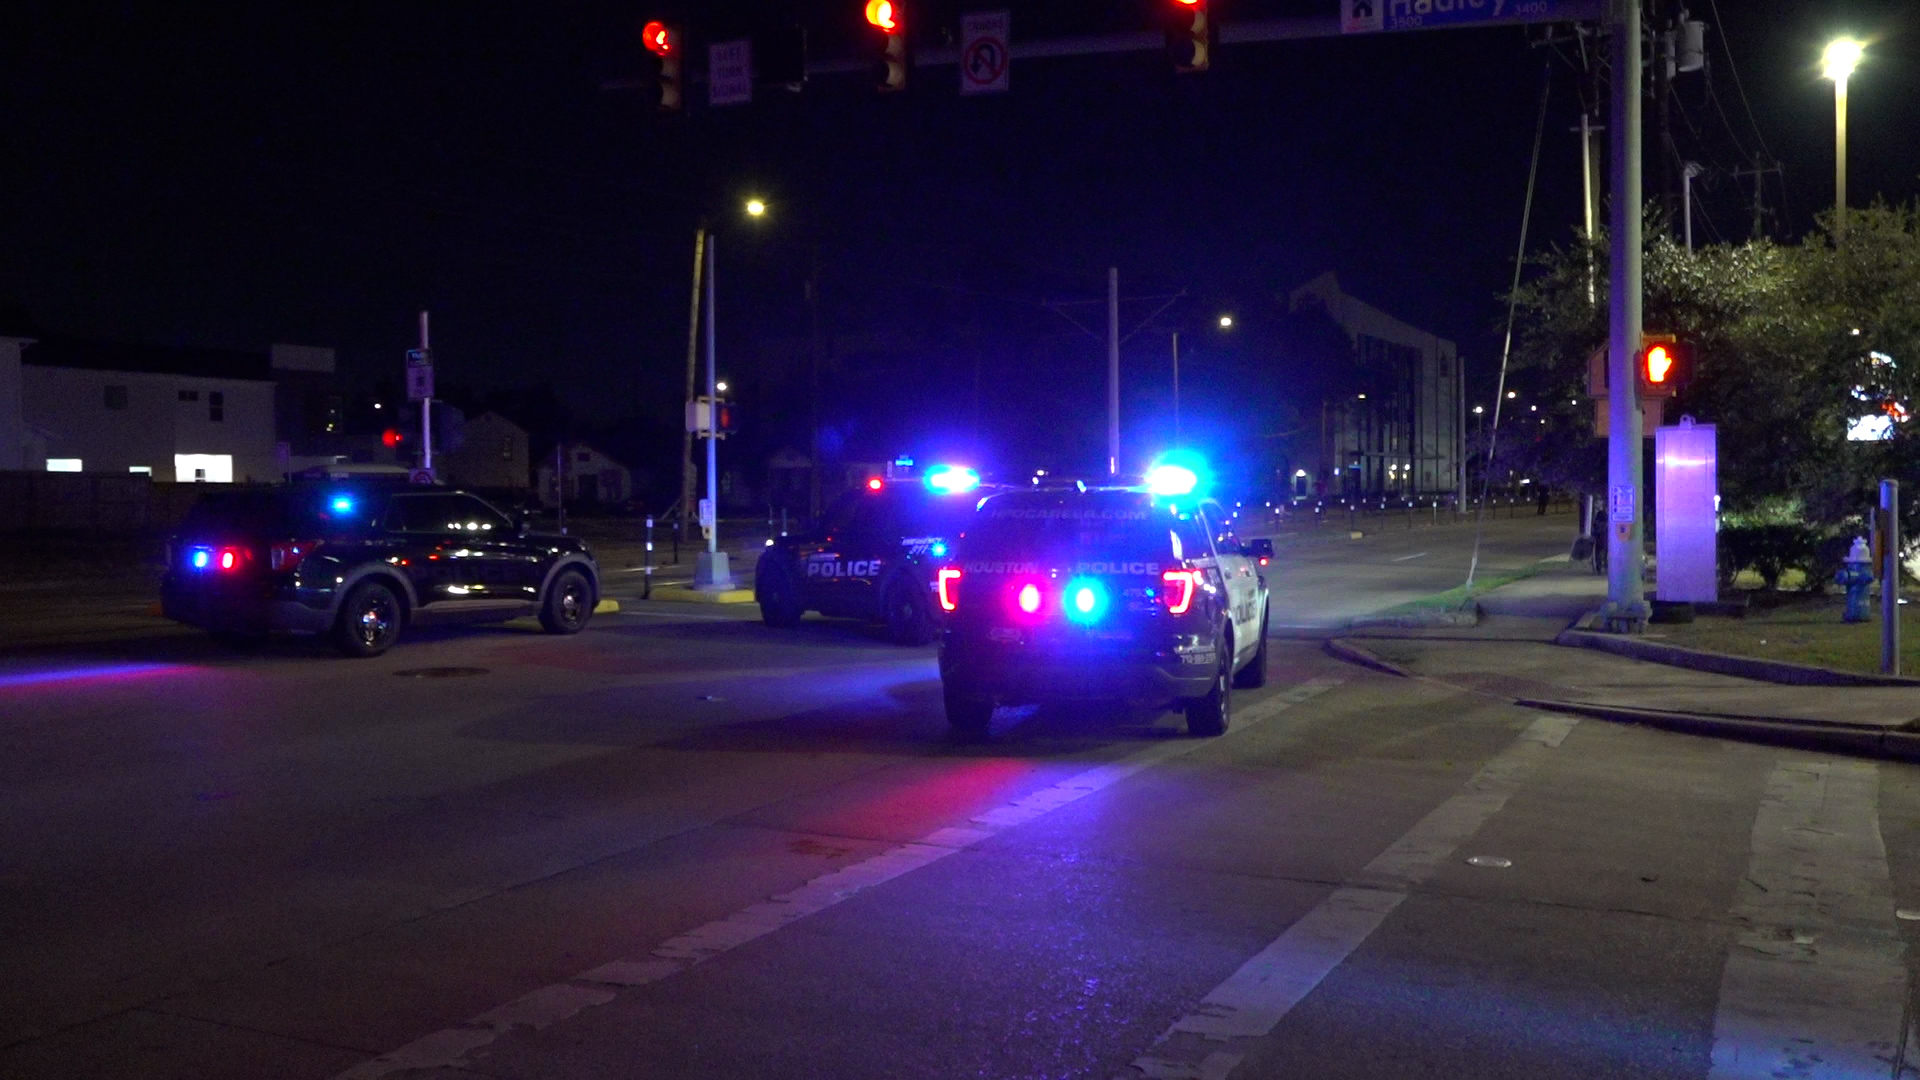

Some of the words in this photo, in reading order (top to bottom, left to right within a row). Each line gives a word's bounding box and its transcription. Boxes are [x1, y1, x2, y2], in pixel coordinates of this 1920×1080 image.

[807, 559, 881, 577] POLICE
[964, 560, 1040, 575] HOUSTON
[1077, 561, 1163, 576] POLICE
